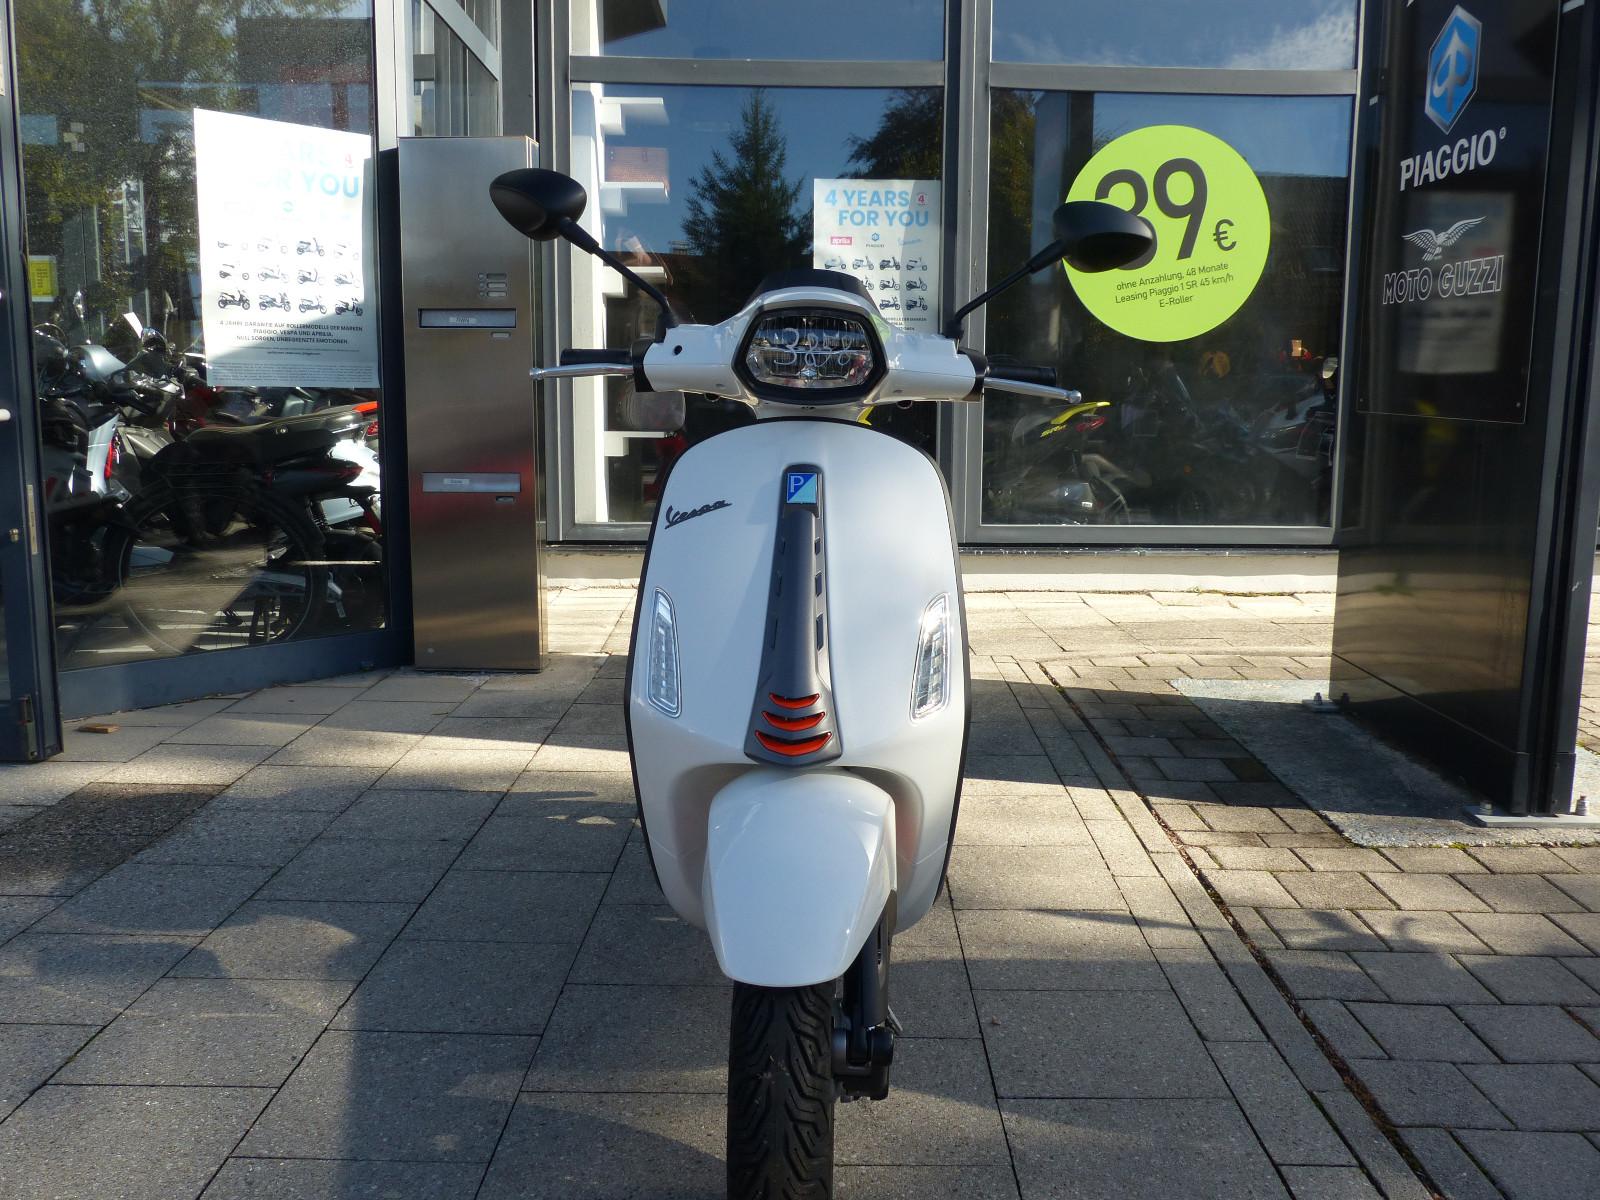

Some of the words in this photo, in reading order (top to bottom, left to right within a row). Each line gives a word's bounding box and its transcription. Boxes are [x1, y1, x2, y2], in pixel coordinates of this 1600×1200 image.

[301, 171, 360, 198] YOU
[824, 189, 838, 207] 4
[842, 190, 910, 207] YEARS
[838, 210, 879, 226] FOR
[884, 210, 929, 227] YOU
[1212, 218, 1238, 251] €
[1115, 290, 1148, 304] Leasing
[1149, 284, 1179, 298] Piaggio
[1186, 279, 1198, 290] SR
[1200, 277, 1210, 287] 45
[1212, 272, 1234, 285] km/h
[1116, 281, 1137, 291] ohne
[1138, 271, 1185, 287] Anzahlung,
[1186, 267, 1197, 277] 48
[1198, 262, 1229, 275] Monate
[1382, 267, 1433, 305] MOTO
[1437, 254, 1505, 298] GUZZI
[1159, 295, 1193, 308] E-Roller
[664, 499, 733, 530] Vespa
